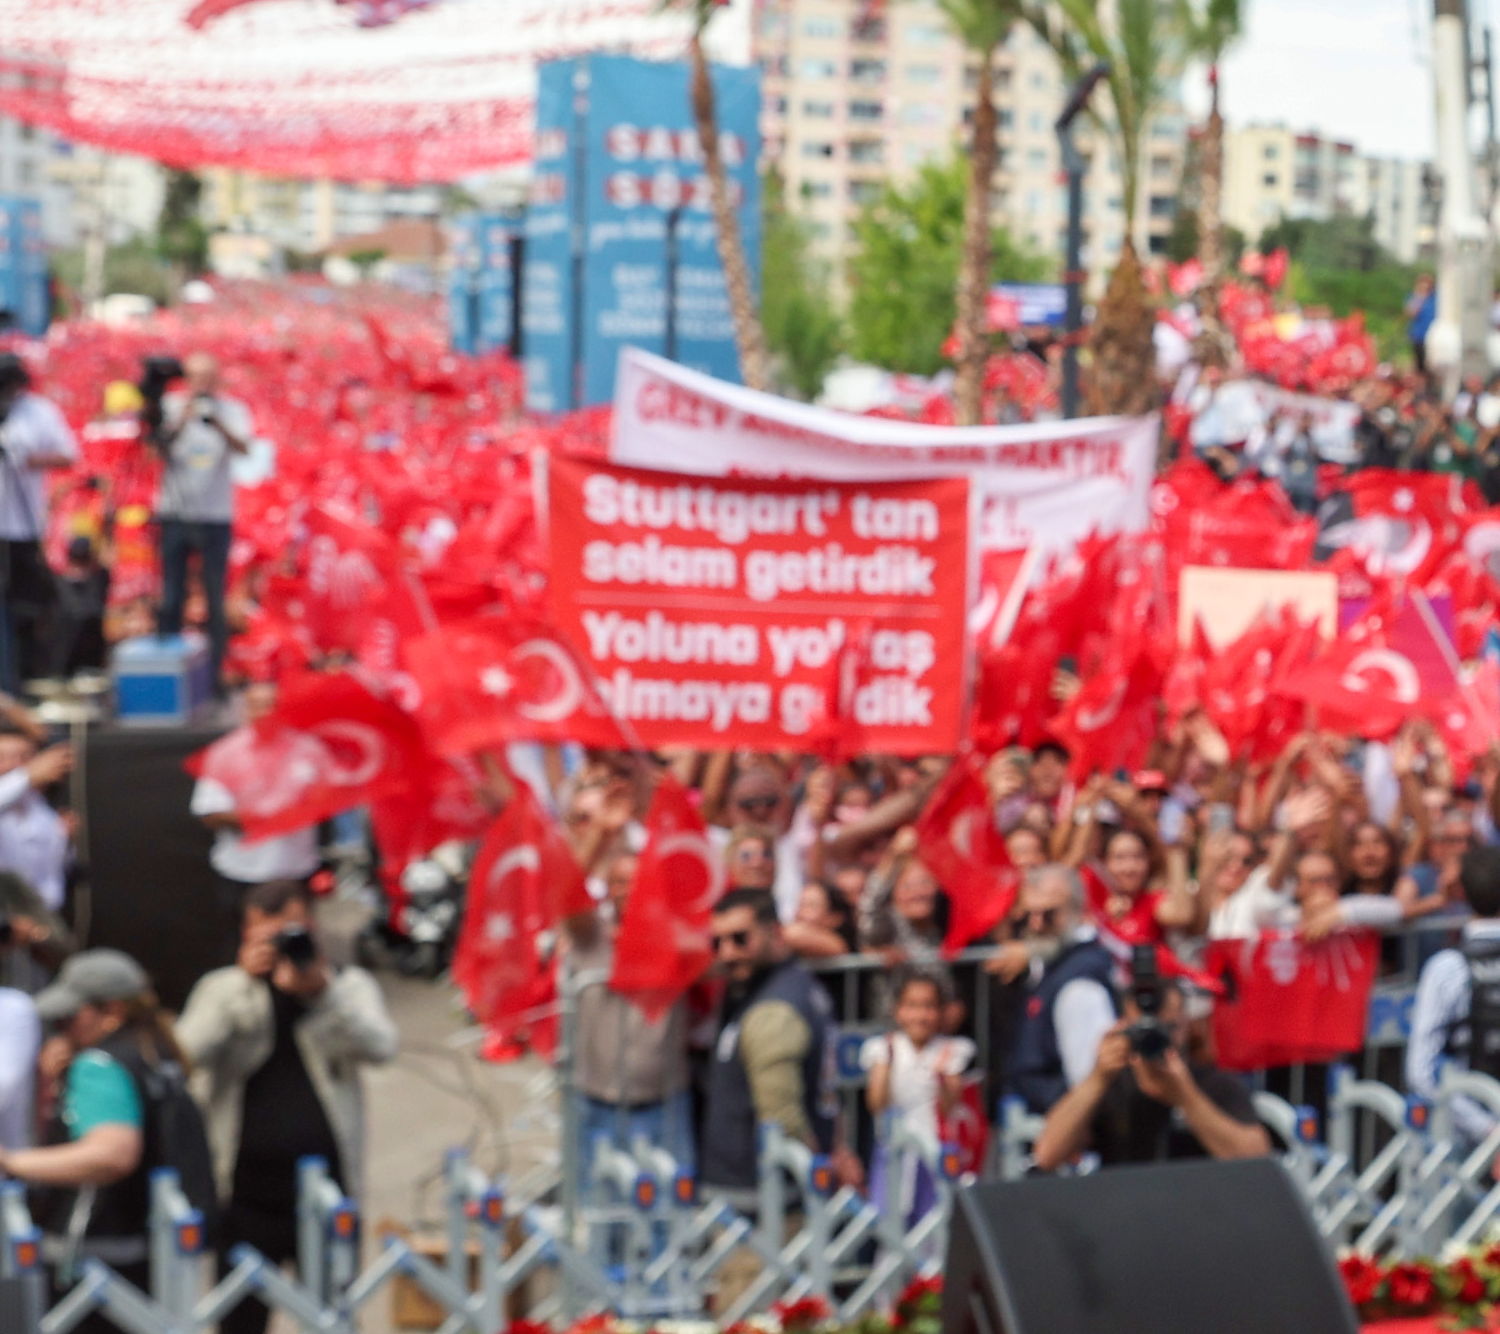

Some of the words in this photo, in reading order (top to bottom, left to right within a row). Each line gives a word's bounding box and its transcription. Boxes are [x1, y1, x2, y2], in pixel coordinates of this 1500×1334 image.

[850, 495, 938, 541] tan
[583, 533, 736, 589] selam
[745, 543, 936, 602] getirdik
[581, 608, 759, 665] Yoluna
[765, 618, 936, 680] yolaş
